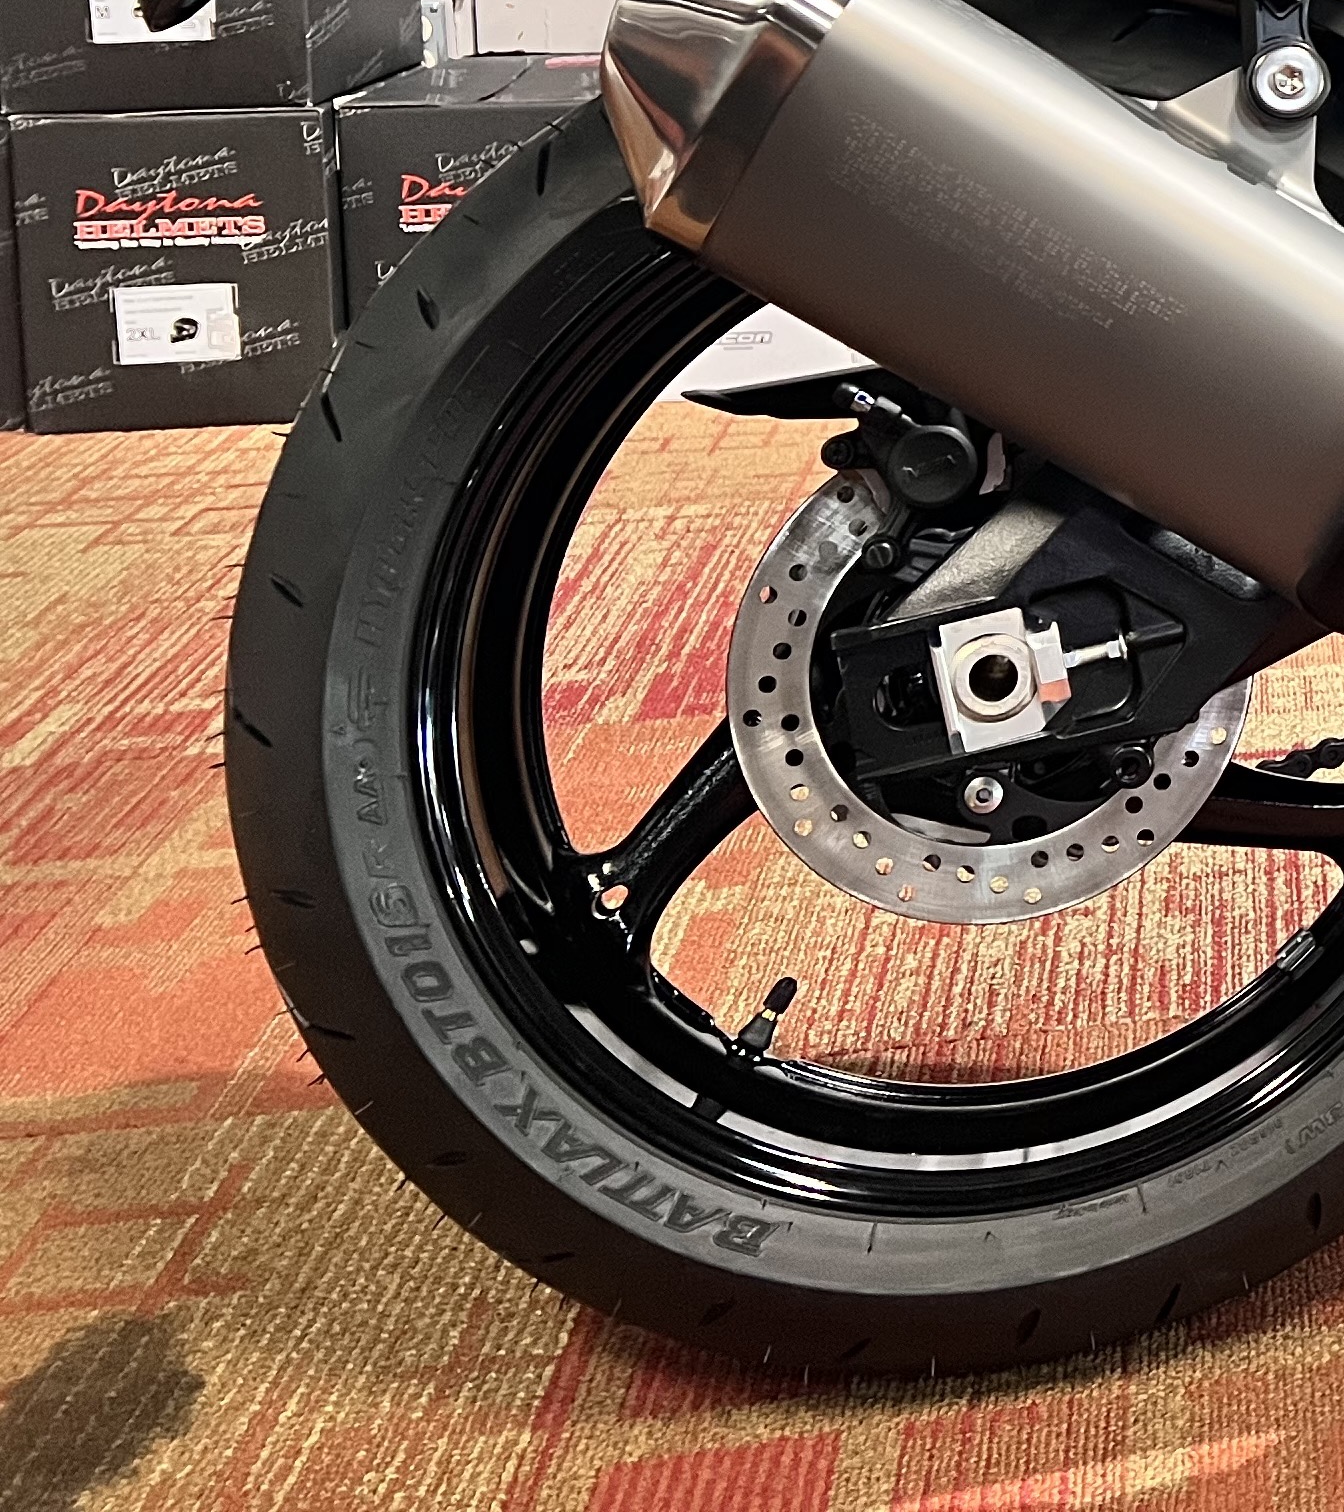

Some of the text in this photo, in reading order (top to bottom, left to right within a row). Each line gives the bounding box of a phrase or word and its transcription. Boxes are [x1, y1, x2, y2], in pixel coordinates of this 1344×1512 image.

[74, 189, 265, 222] Daytona
[73, 215, 267, 240] HELMETS
[125, 327, 161, 343] 2XL
[717, 330, 773, 346] con
